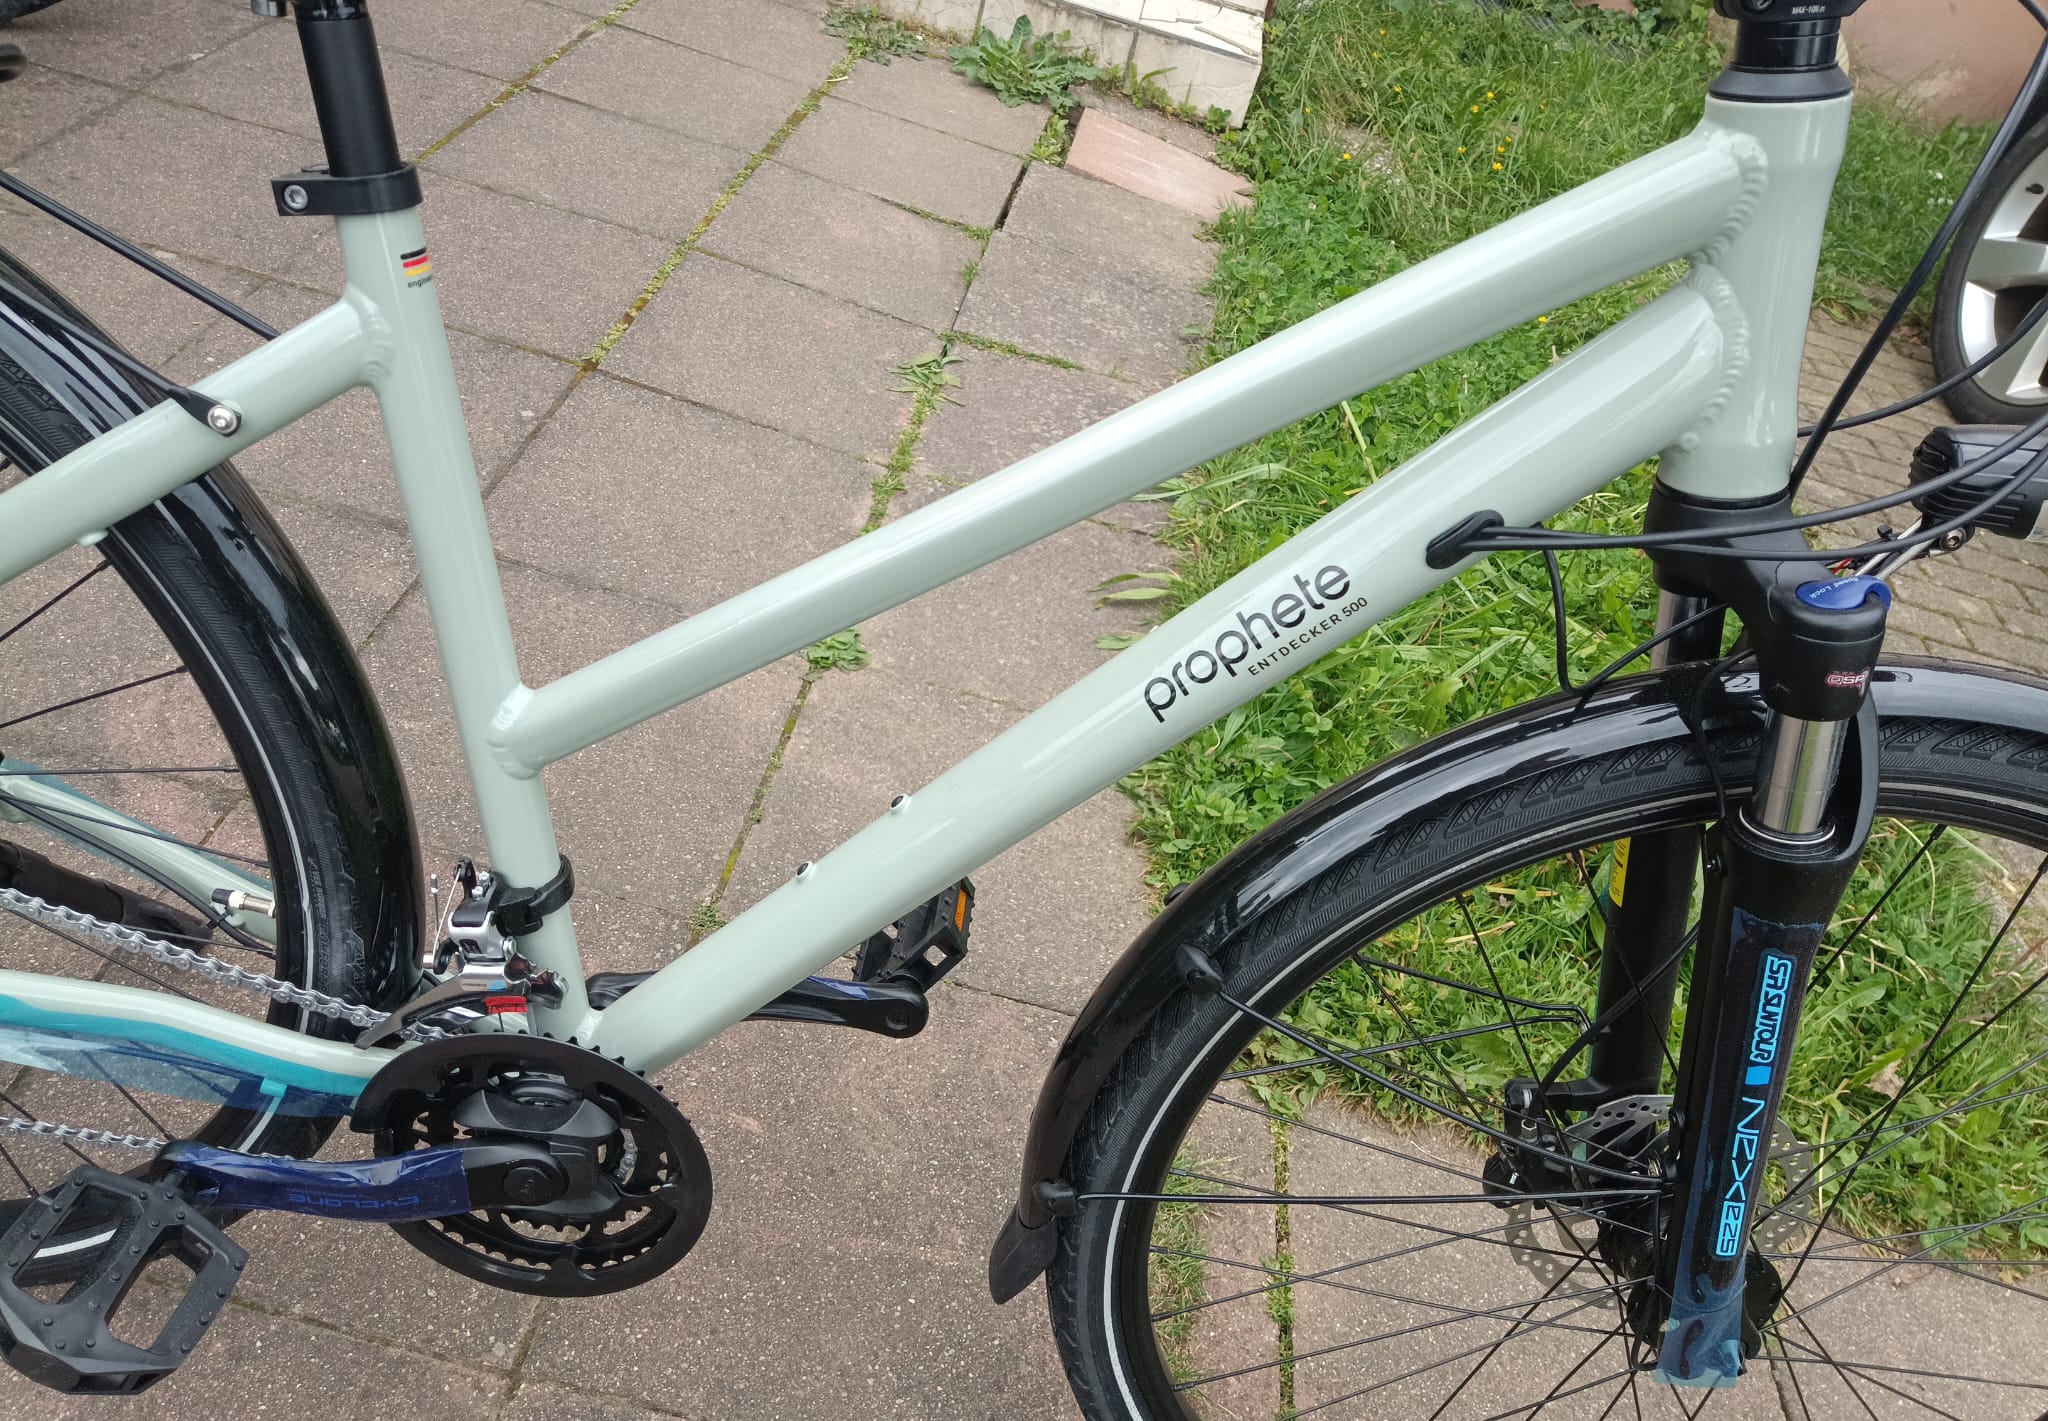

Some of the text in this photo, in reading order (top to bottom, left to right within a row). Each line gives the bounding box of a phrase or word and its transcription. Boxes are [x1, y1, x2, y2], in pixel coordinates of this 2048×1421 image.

[1809, 585, 1832, 599] Lock
[1144, 565, 1351, 723] prophete
[1248, 597, 1368, 676] ENTDECKER 500
